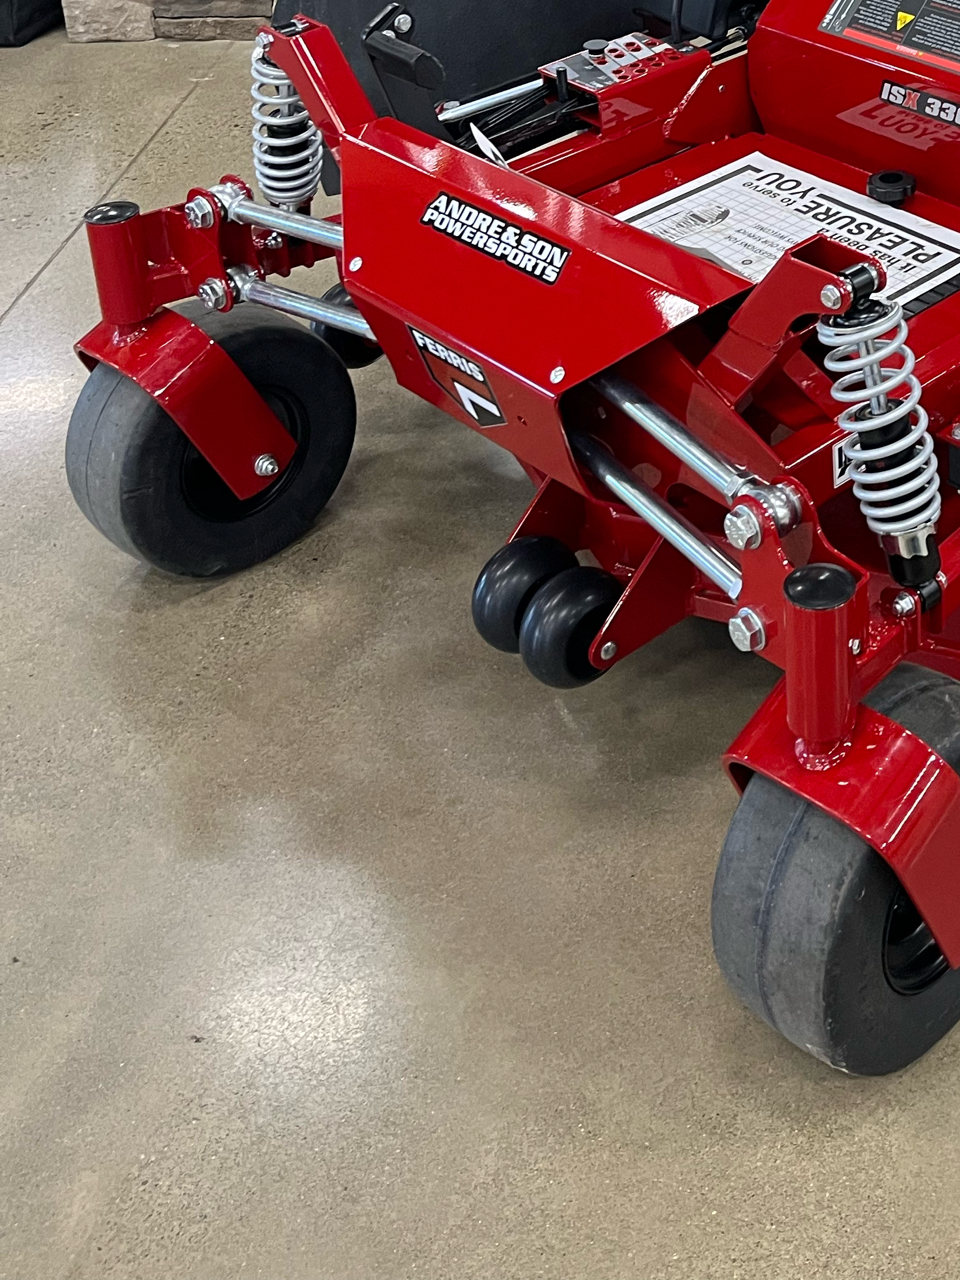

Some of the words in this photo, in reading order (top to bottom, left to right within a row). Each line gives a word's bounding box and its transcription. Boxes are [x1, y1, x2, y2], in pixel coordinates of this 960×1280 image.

[881, 83, 920, 110] ISX
[742, 181, 781, 201] serve
[756, 172, 814, 200] YOU
[780, 196, 797, 207] to
[791, 197, 942, 265] PLEASURE
[423, 209, 560, 283] POWERSPORTS
[873, 250, 899, 266] has
[901, 263, 917, 273] It
[412, 330, 485, 382] FERRIS
